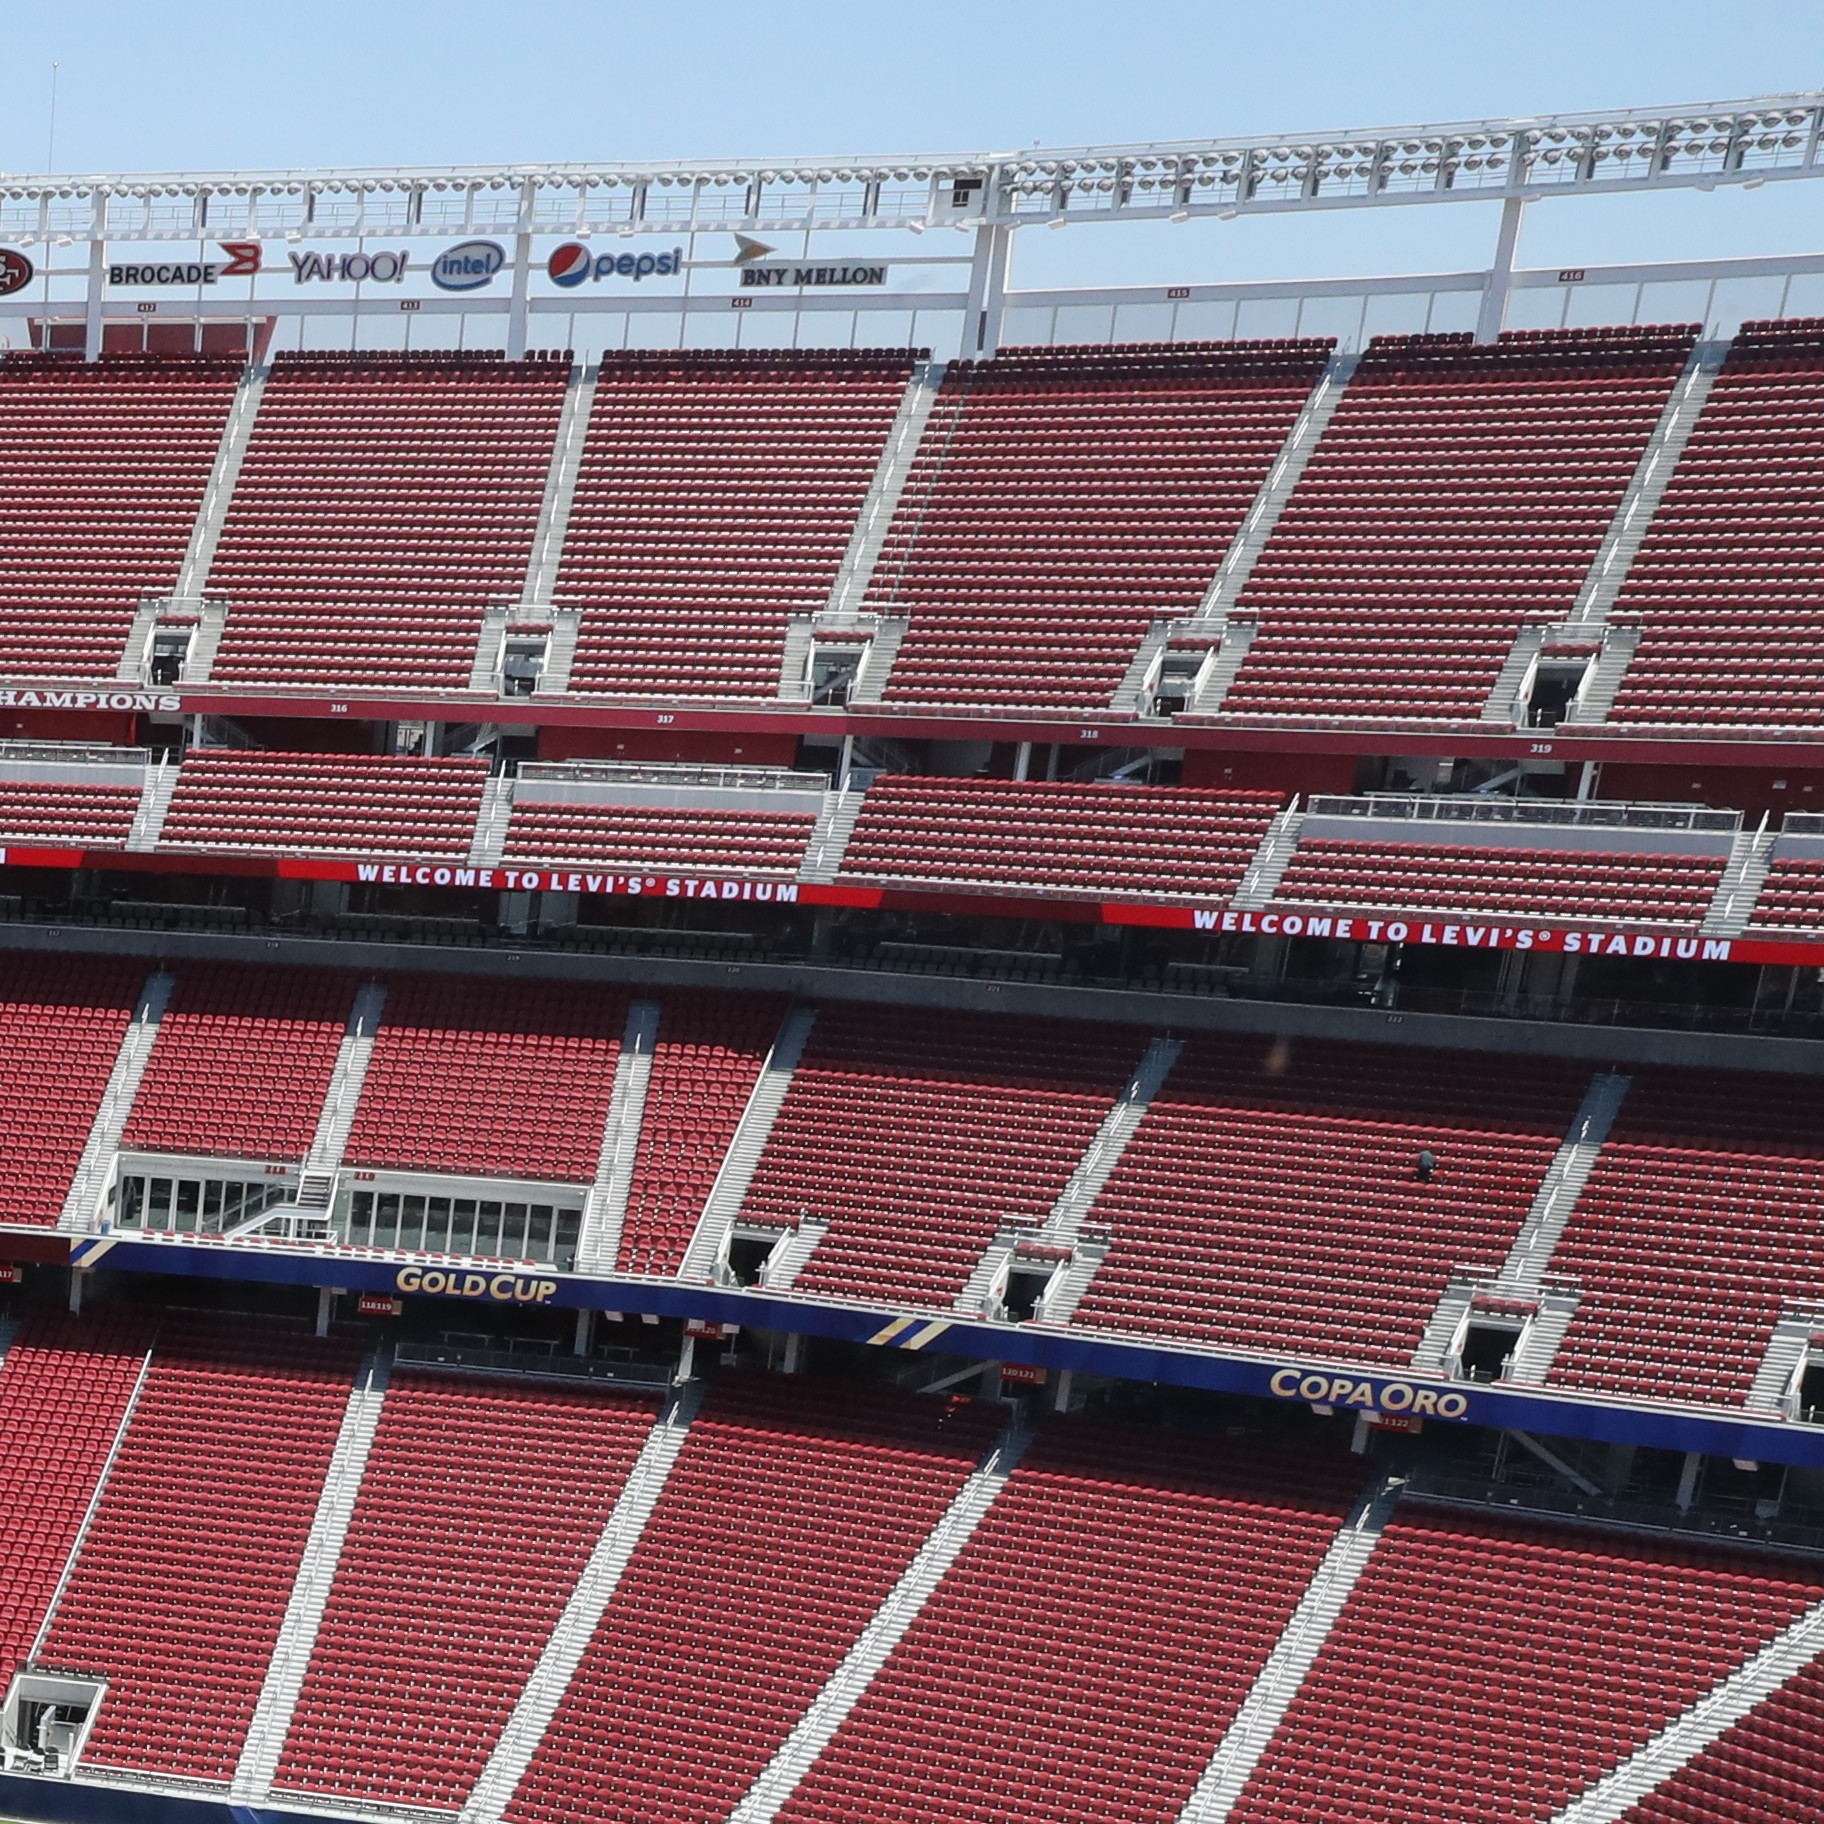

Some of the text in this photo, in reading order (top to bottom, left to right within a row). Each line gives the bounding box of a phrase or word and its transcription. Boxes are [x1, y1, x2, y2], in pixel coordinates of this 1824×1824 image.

[110, 265, 217, 285] BROCADE
[288, 251, 409, 283] YAHOO!
[441, 251, 492, 277] intel
[593, 248, 682, 282] pepsi
[743, 266, 886, 286] BNY MELLON
[331, 704, 348, 713] 316
[657, 715, 674, 723] 317
[1080, 729, 1099, 738] 318
[1531, 744, 1552, 753] 319
[357, 864, 493, 888] WELCOME
[505, 870, 540, 890] TO
[665, 878, 799, 902] STADIUM
[1193, 909, 1354, 939] WELCOME
[1367, 920, 1408, 941] TO
[1563, 932, 1732, 961] STADIUM
[396, 1266, 557, 1302] GOLD CUP
[1270, 1368, 1468, 1418] COPA ORO
